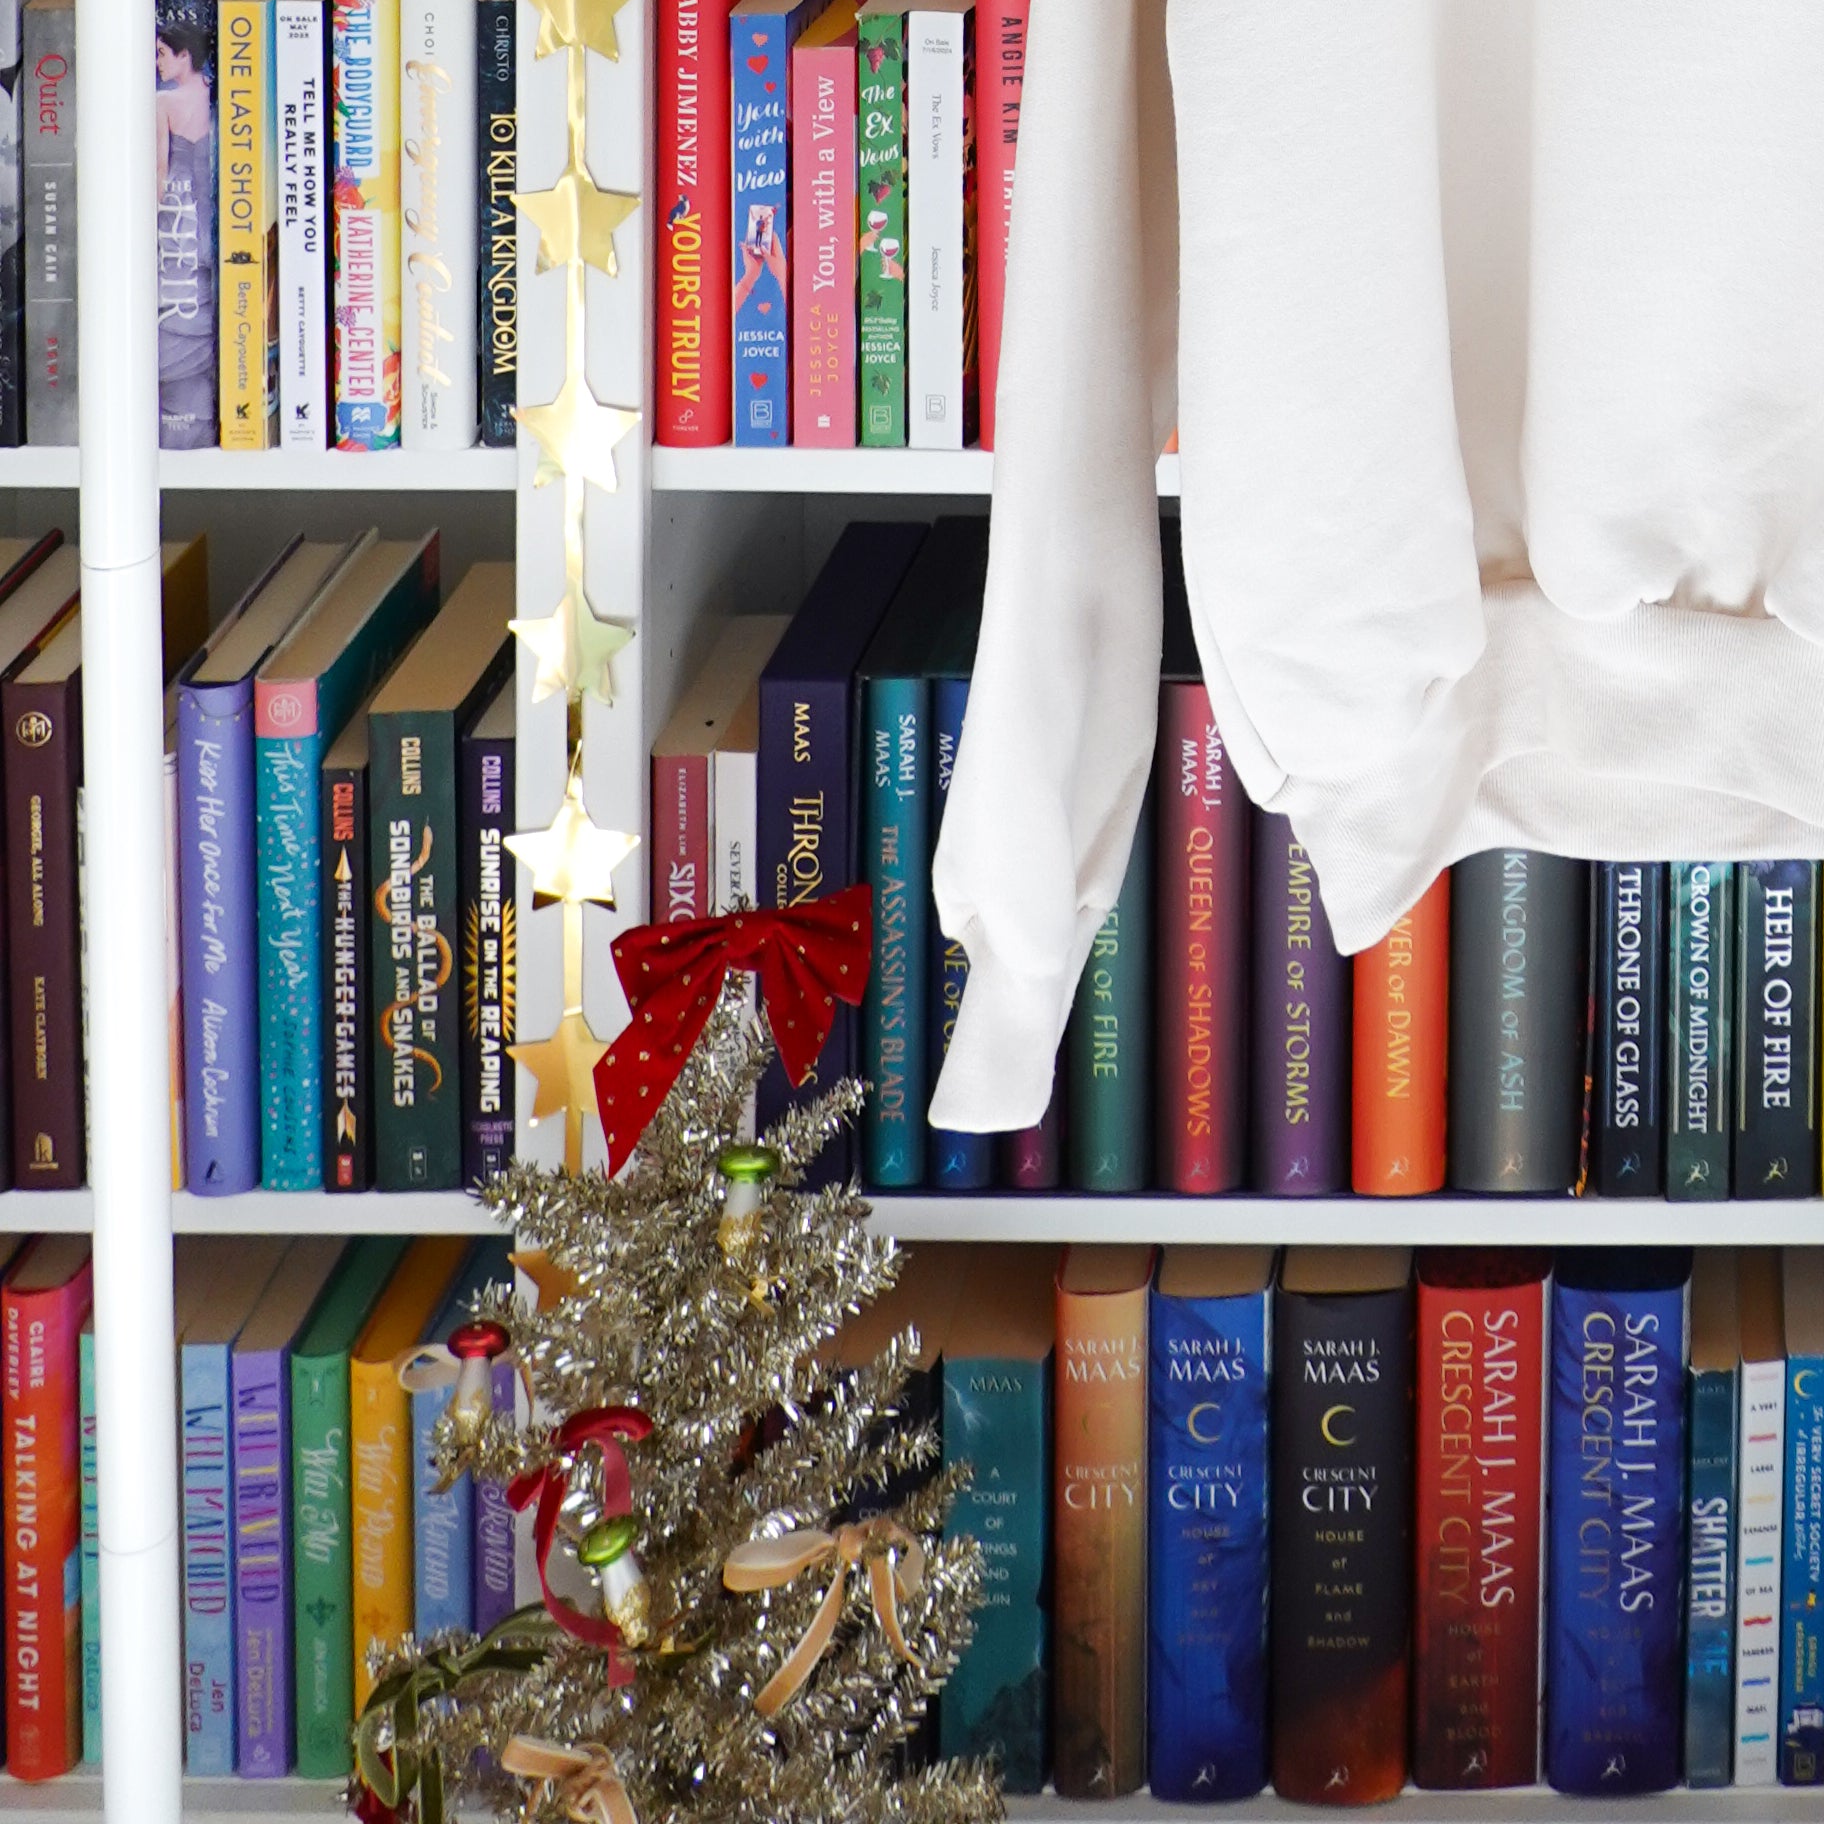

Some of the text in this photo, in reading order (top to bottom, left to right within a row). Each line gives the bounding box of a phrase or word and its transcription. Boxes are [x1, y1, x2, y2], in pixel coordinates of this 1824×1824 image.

[35, 55, 68, 135] Quiet
[230, 17, 253, 235] ONE LAST SHOT
[677, 68, 699, 187] JIMENEZ
[671, 213, 701, 402] YOURS TRULY
[738, 331, 784, 343] JESSICA
[743, 346, 779, 357] JOYCE
[480, 828, 501, 1114] SUNRISE ON THE REAPING
[1188, 828, 1215, 1137] QUEEN OF SHADOWS
[1763, 887, 1794, 1110] HEIR OF FIRE
[1304, 1359, 1379, 1382] MAAS
[16, 1416, 38, 1710] TALKING AT NIGHT
[1302, 1483, 1377, 1511] CITY
